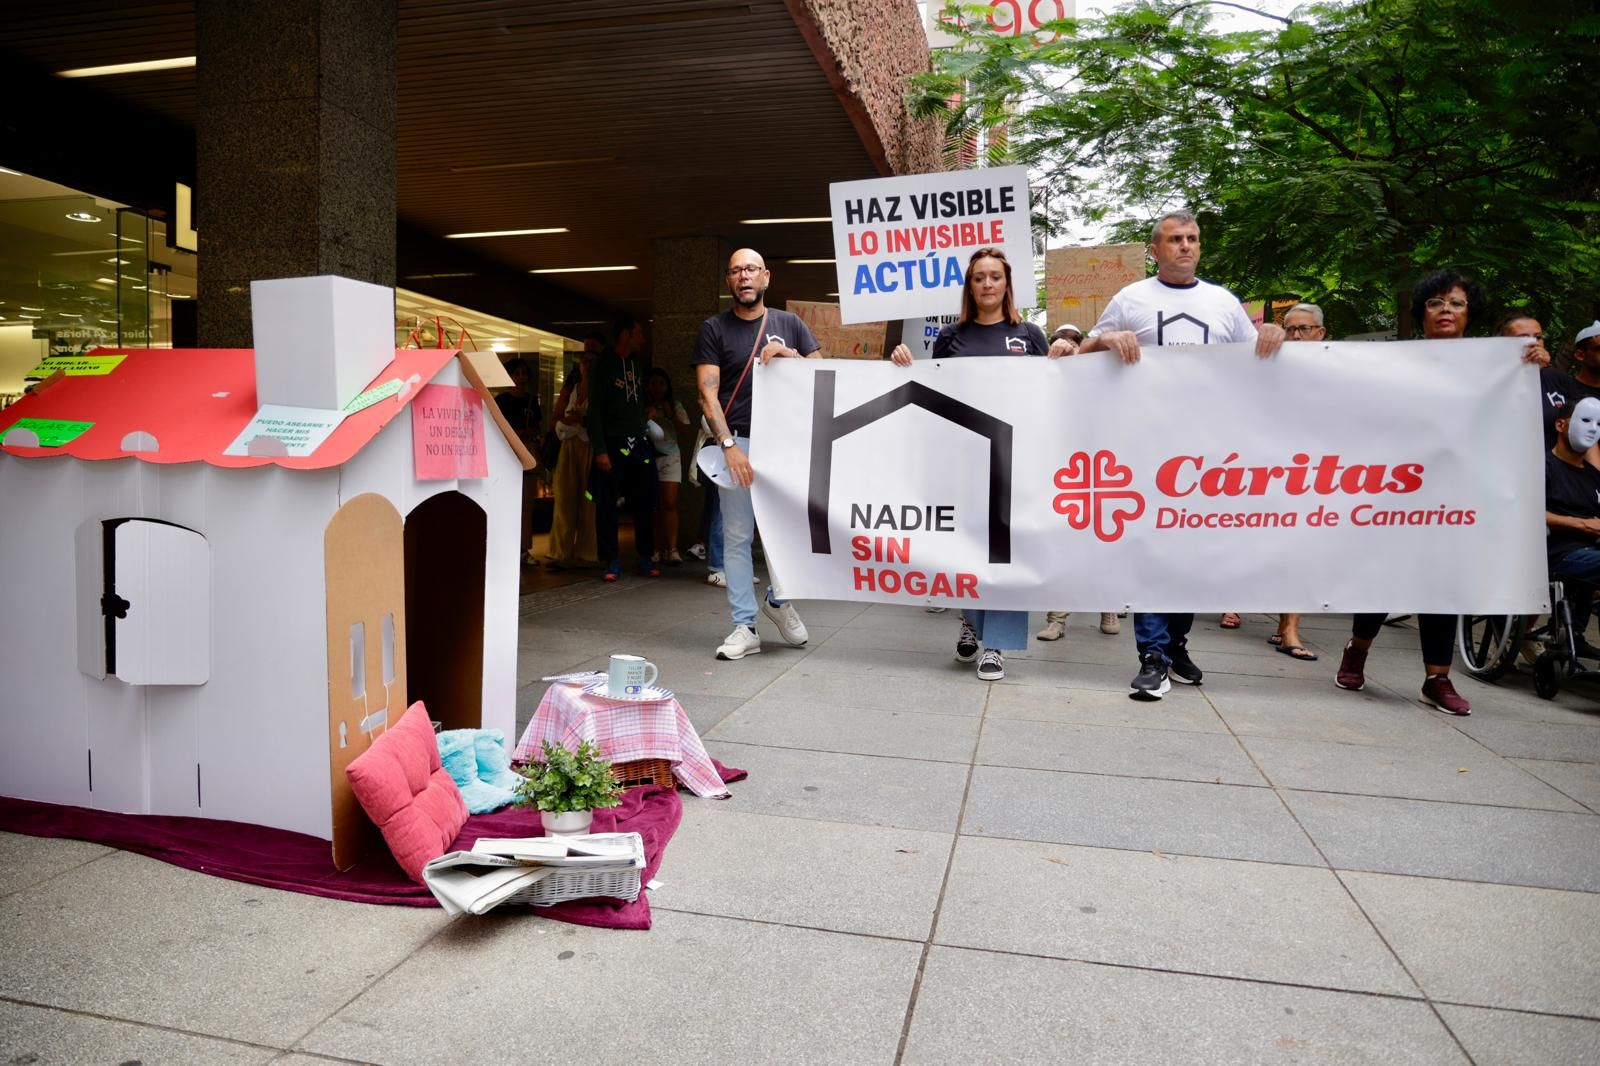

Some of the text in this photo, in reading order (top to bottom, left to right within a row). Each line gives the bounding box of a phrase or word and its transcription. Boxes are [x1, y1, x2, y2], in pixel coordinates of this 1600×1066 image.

[845, 186, 1015, 225] HAZ VISIBLE
[848, 220, 1005, 256] LO INVISIBLE
[853, 251, 965, 296] ACTÚA
[422, 407, 435, 419] LA
[429, 425, 443, 438] UN
[425, 444, 440, 456] NO
[441, 444, 454, 456] UN
[1156, 453, 1424, 498] Cáritas
[851, 503, 955, 532] NADIE
[1156, 504, 1476, 529] Diocesana de Canarias
[851, 535, 911, 564] SIN
[853, 567, 980, 599] HOGAR
